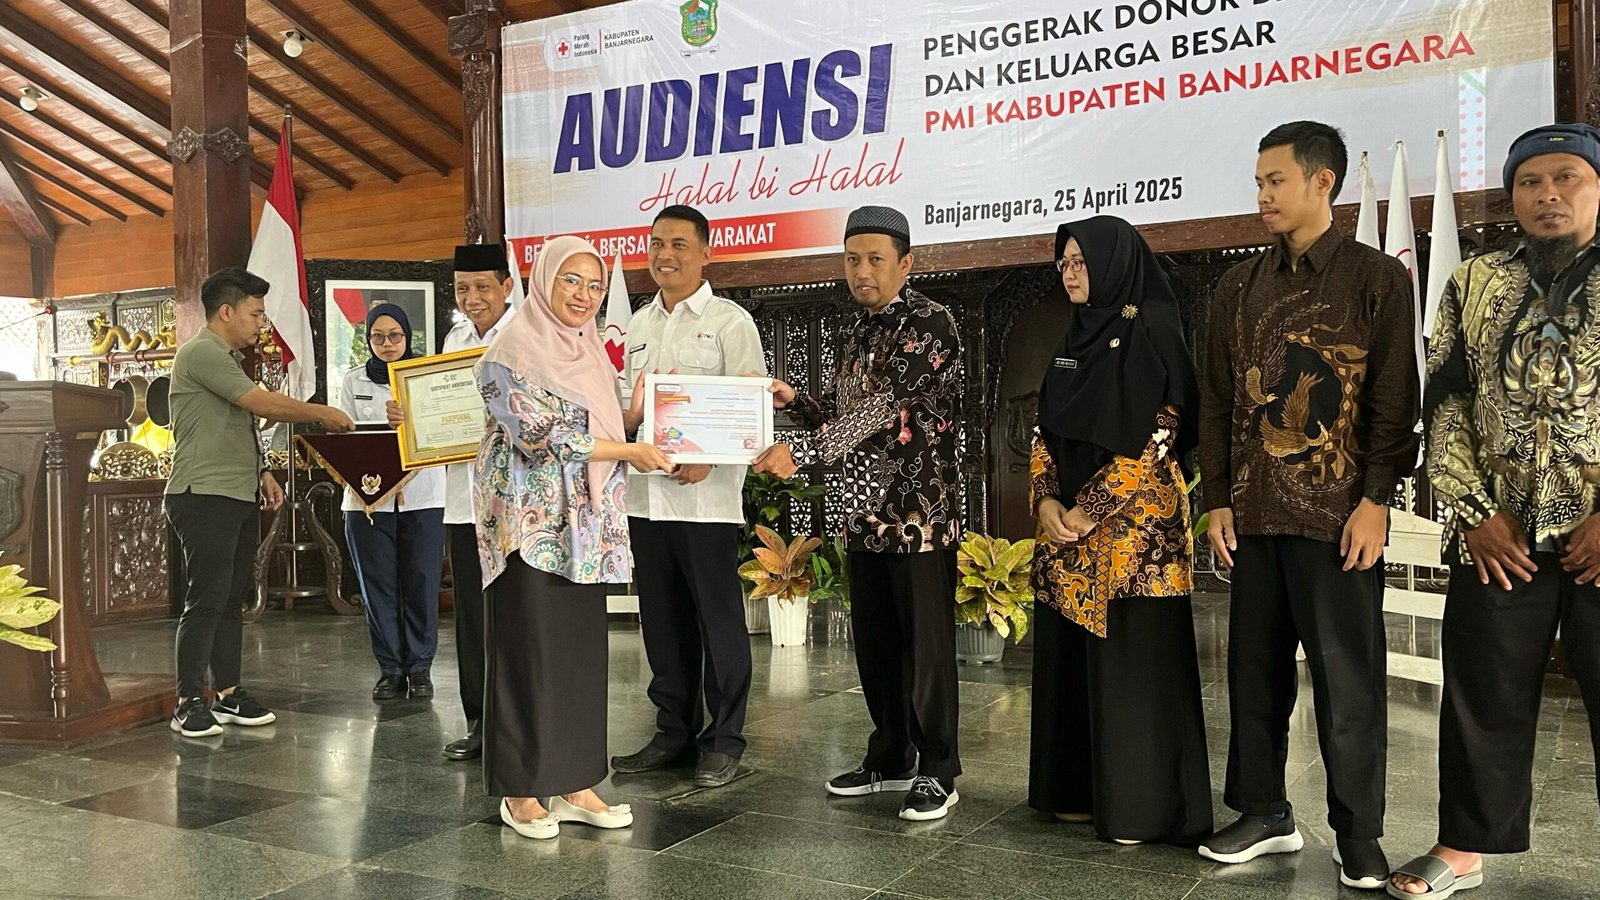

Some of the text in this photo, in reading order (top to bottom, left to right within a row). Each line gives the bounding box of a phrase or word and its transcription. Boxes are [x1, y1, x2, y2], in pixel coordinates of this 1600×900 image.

[574, 33, 590, 41] Palang
[574, 42, 590, 50] Merah
[574, 48, 597, 57] Indonesia
[604, 29, 640, 41] KABUPATEN
[604, 35, 654, 49] BANJARNEGARA
[924, 9, 1104, 60] PENGGERAK
[925, 20, 1276, 97] DAN KELUARGA BESAR
[925, 30, 1476, 133] PMI KABUPATEN BANJARNEGARA
[553, 43, 893, 175] AUDIENSI
[639, 137, 905, 212] Halal bi Halal
[924, 176, 1183, 228] Banjarnegara, 25 April 2025
[600, 234, 652, 257] BERSA
